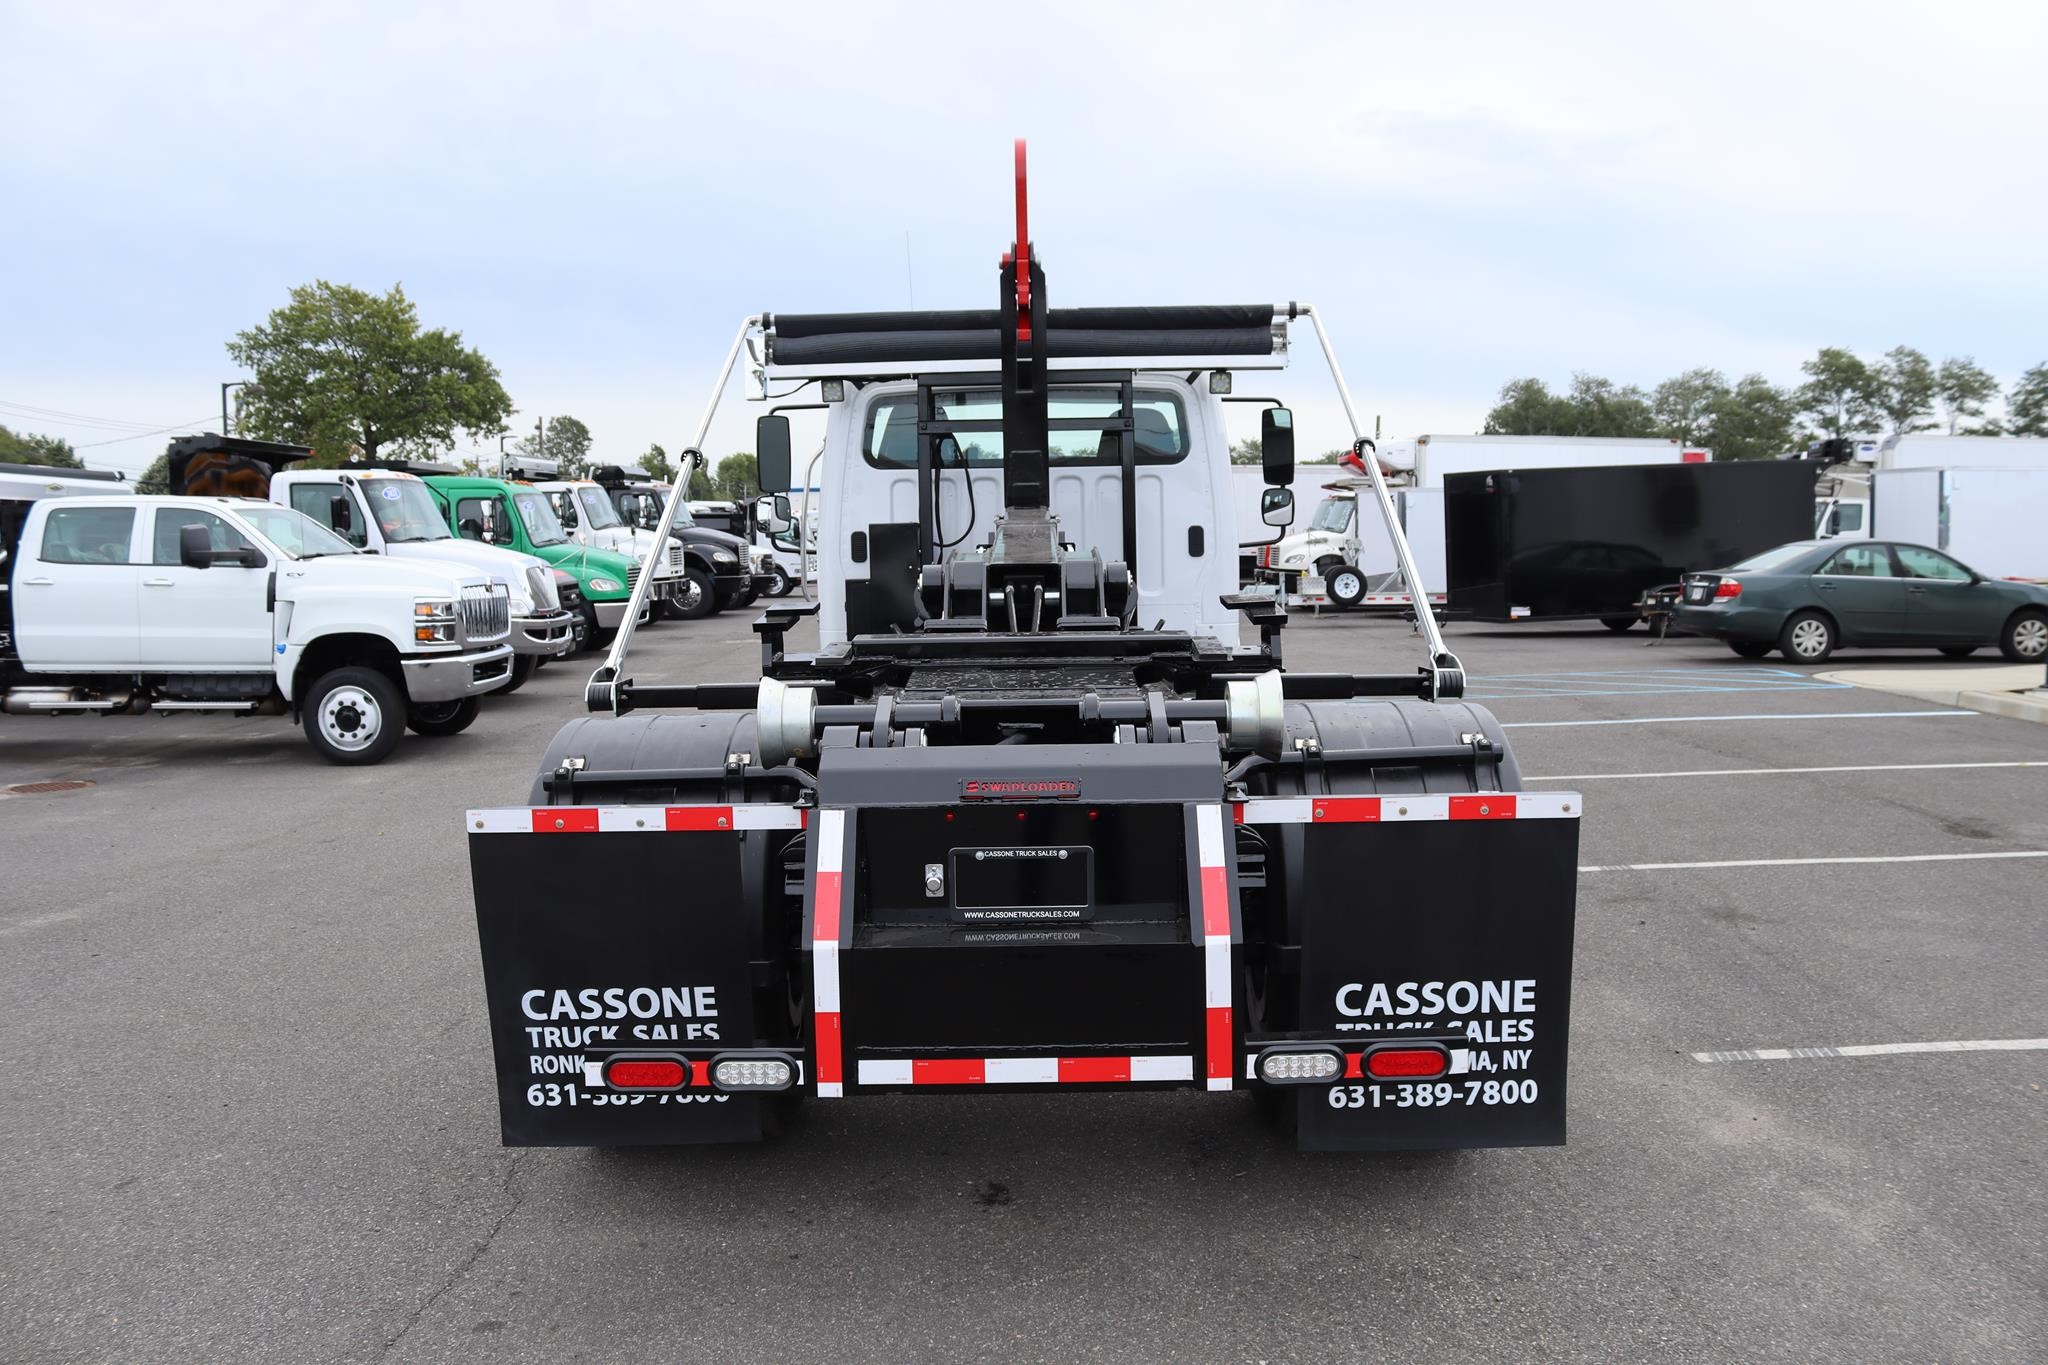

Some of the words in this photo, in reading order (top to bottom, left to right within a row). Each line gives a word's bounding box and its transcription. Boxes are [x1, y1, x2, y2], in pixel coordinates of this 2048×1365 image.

[981, 781, 1075, 792] SWAPLOADER
[964, 911, 1080, 919] WWW.CASSONETRUCKSALES.COM
[521, 986, 719, 1021] CASSONE
[1335, 980, 1537, 1017] CASSONE
[525, 1025, 620, 1048] TRUCK
[1447, 1019, 1535, 1043] ALES
[1502, 1049, 1533, 1071] NY
[1328, 1079, 1538, 1109] 631-389-7800
